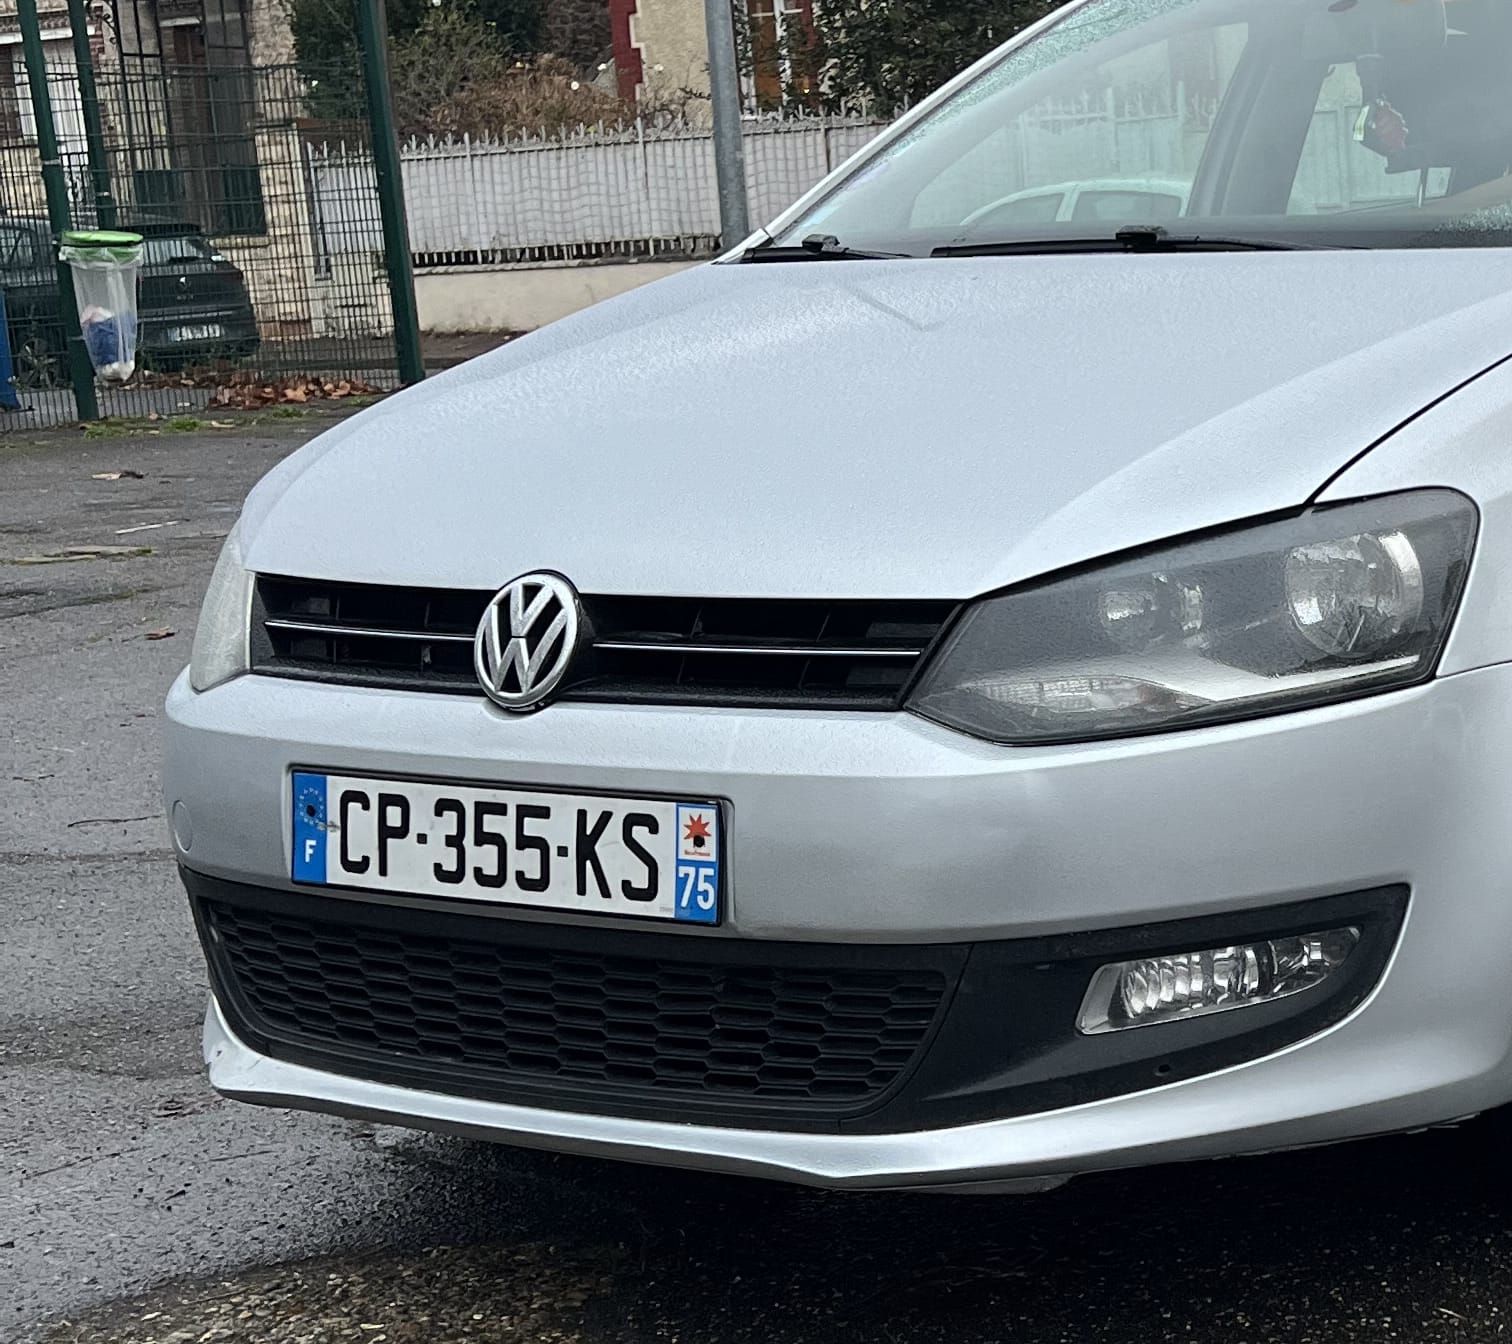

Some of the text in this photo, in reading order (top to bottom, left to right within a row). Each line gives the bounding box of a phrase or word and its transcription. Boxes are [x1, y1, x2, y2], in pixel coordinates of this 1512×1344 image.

[475, 573, 578, 706] VW
[304, 839, 317, 863] F
[339, 789, 659, 902] CP-355-KS
[678, 867, 716, 909] 75
